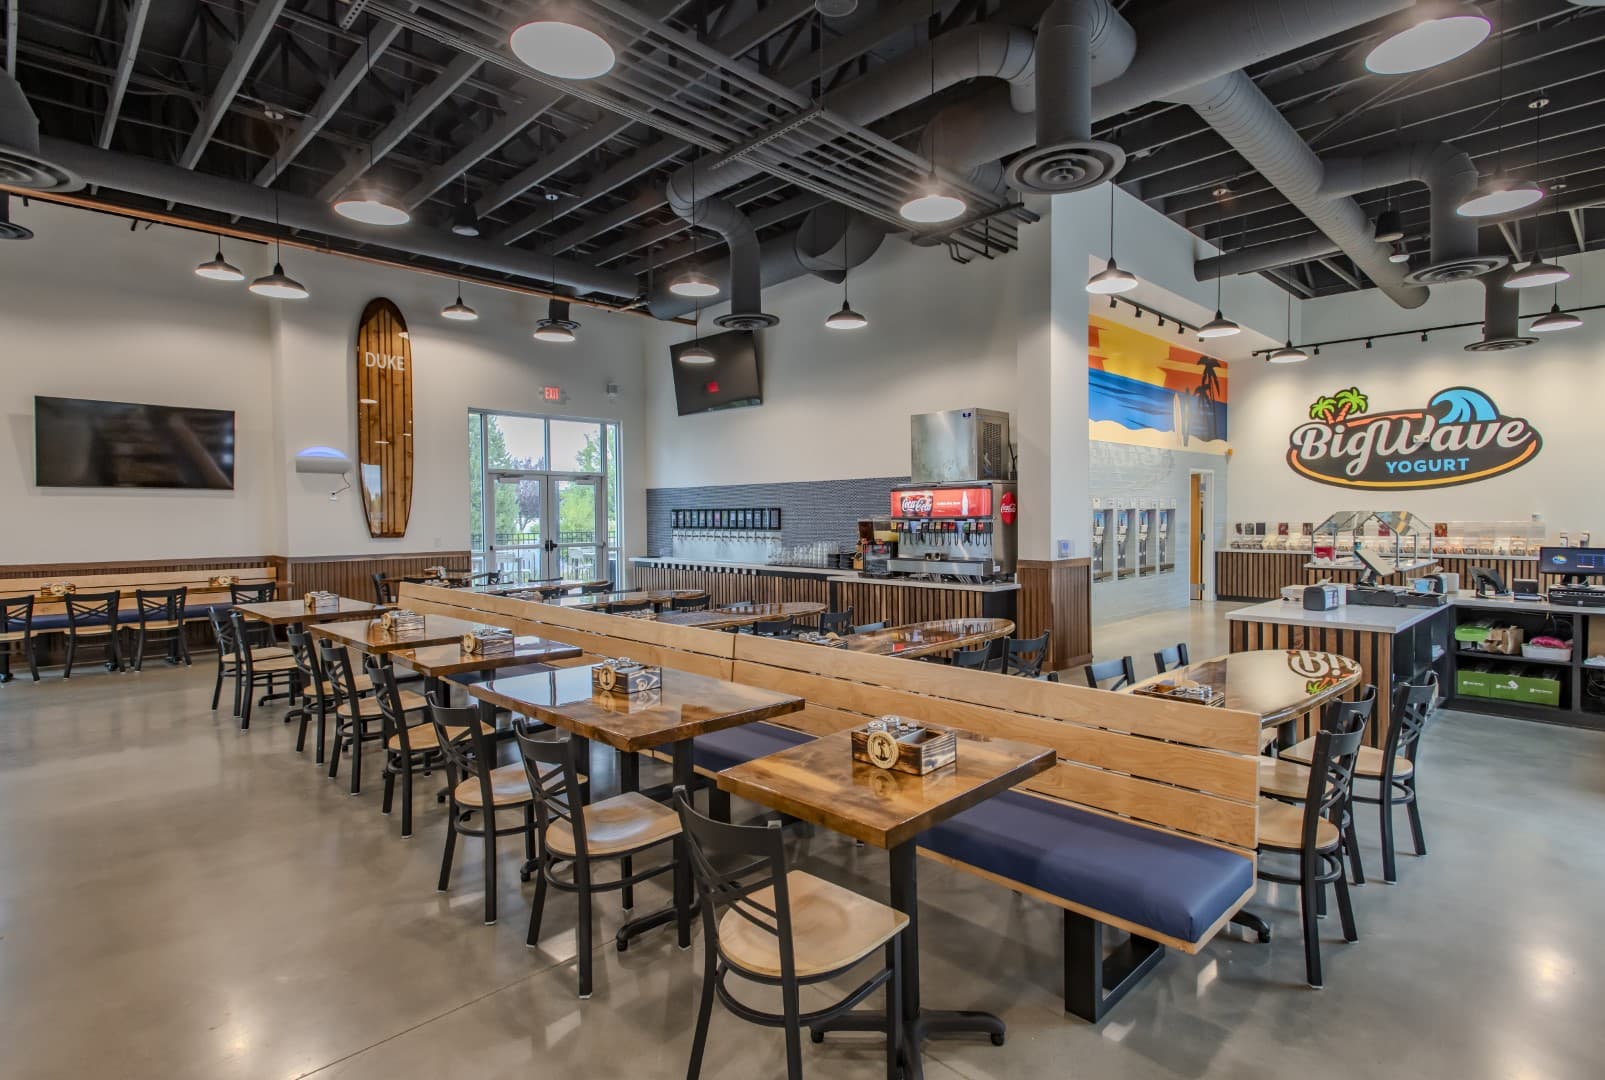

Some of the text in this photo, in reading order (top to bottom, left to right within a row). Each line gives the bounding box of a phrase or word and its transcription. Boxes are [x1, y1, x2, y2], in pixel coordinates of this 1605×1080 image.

[365, 351, 405, 371] DUKE
[544, 386, 559, 400] EXIT
[1385, 457, 1470, 474] YOGURT
